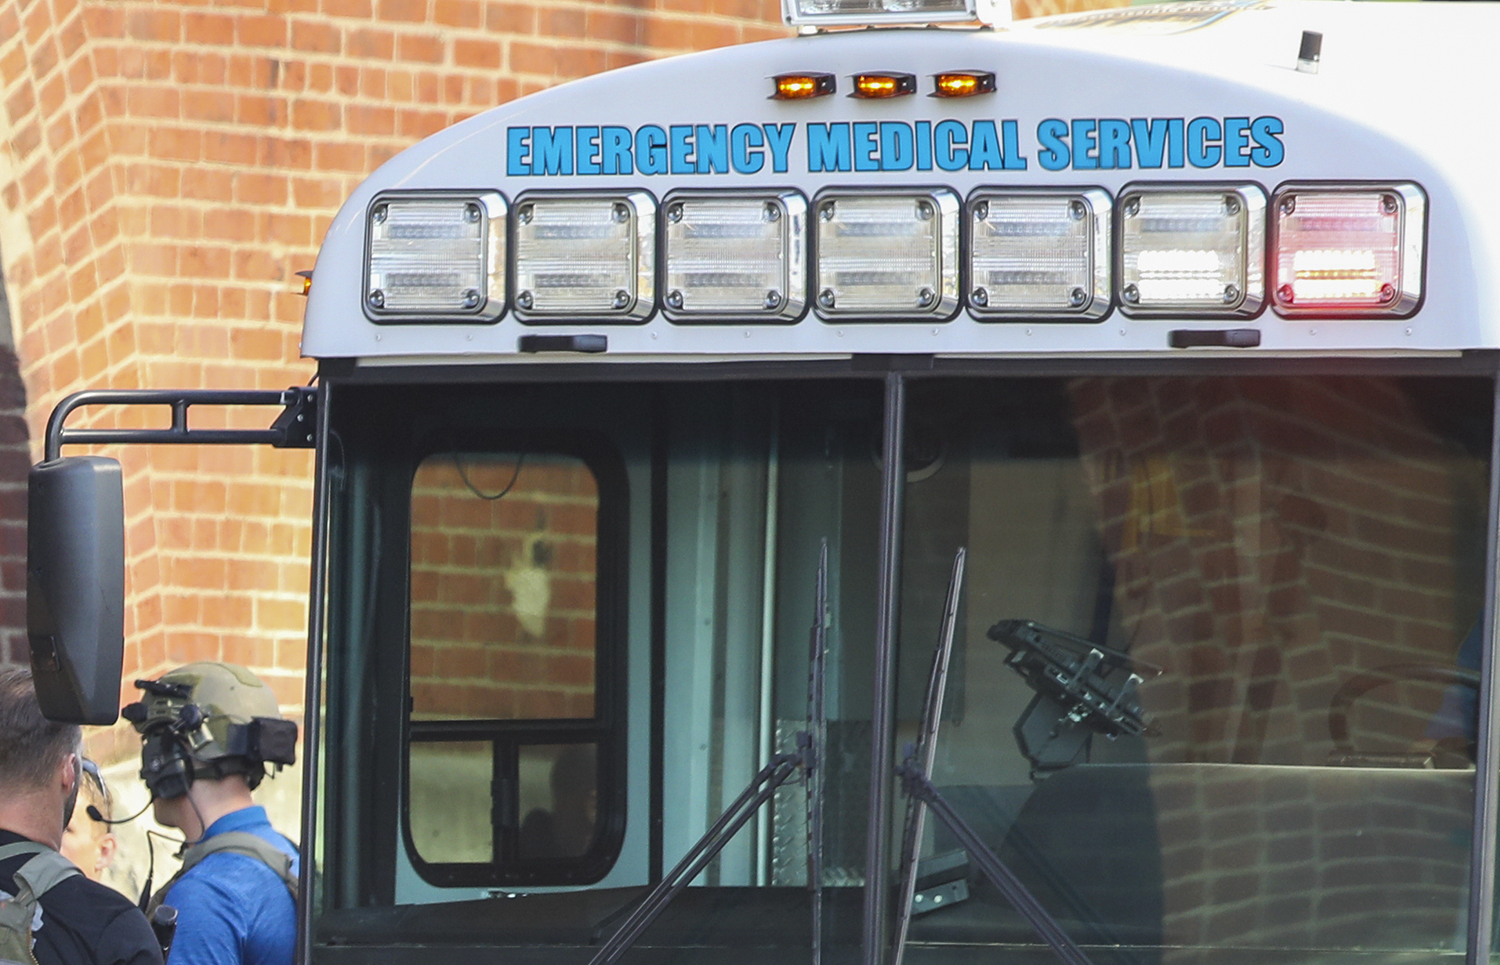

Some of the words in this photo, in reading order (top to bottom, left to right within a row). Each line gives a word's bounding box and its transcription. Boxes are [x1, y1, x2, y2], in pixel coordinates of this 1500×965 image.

[506, 123, 797, 176] EMERGENCY
[806, 119, 1028, 173] MEDICAL
[1036, 116, 1285, 171] SERVICES
